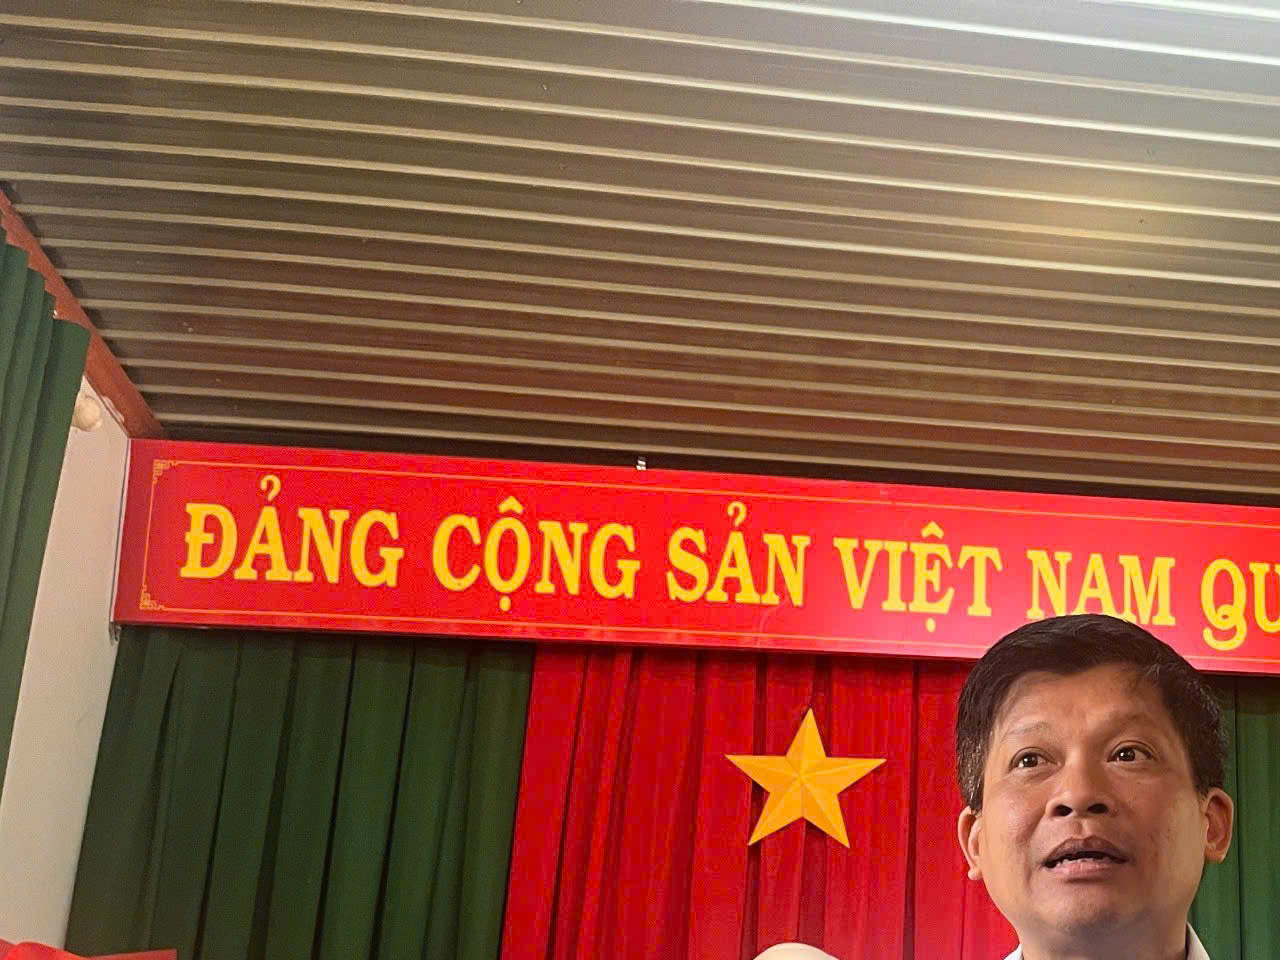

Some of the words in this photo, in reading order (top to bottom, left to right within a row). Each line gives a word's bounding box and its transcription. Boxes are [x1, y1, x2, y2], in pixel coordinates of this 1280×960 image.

[181, 475, 404, 586] ĐẢNG
[433, 496, 640, 611] CỘNG
[667, 501, 809, 606] SẢN
[833, 521, 1003, 632] VIỆT
[1026, 549, 1176, 626] NAM
